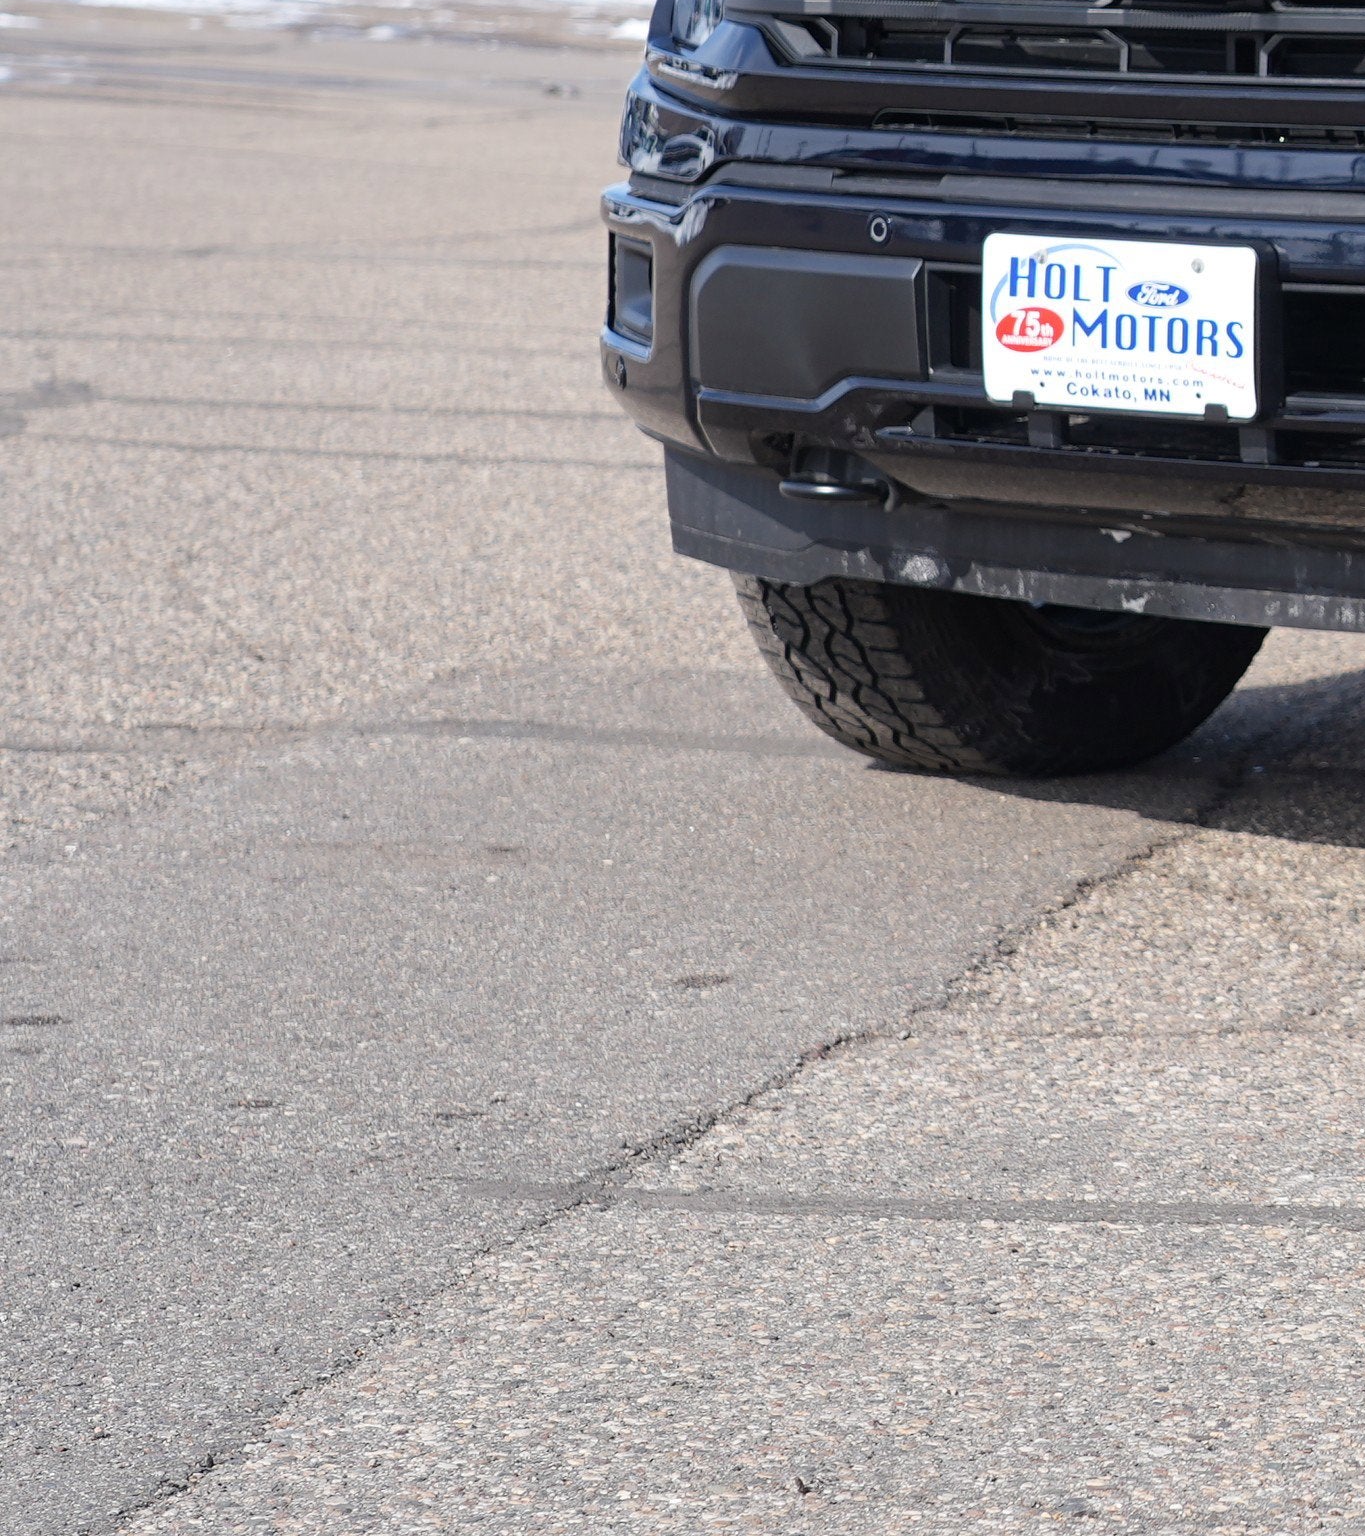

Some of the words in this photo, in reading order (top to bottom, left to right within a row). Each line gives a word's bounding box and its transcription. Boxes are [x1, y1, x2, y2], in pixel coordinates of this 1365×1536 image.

[1009, 256, 1118, 303] HOLT
[1136, 282, 1181, 307] Ford
[1010, 309, 1055, 338] 75th
[1072, 307, 1244, 359] MOTORS
[1030, 367, 1204, 388] www.holtmotors.com
[1066, 381, 1139, 403] Cokato,
[1144, 388, 1171, 403] MN
